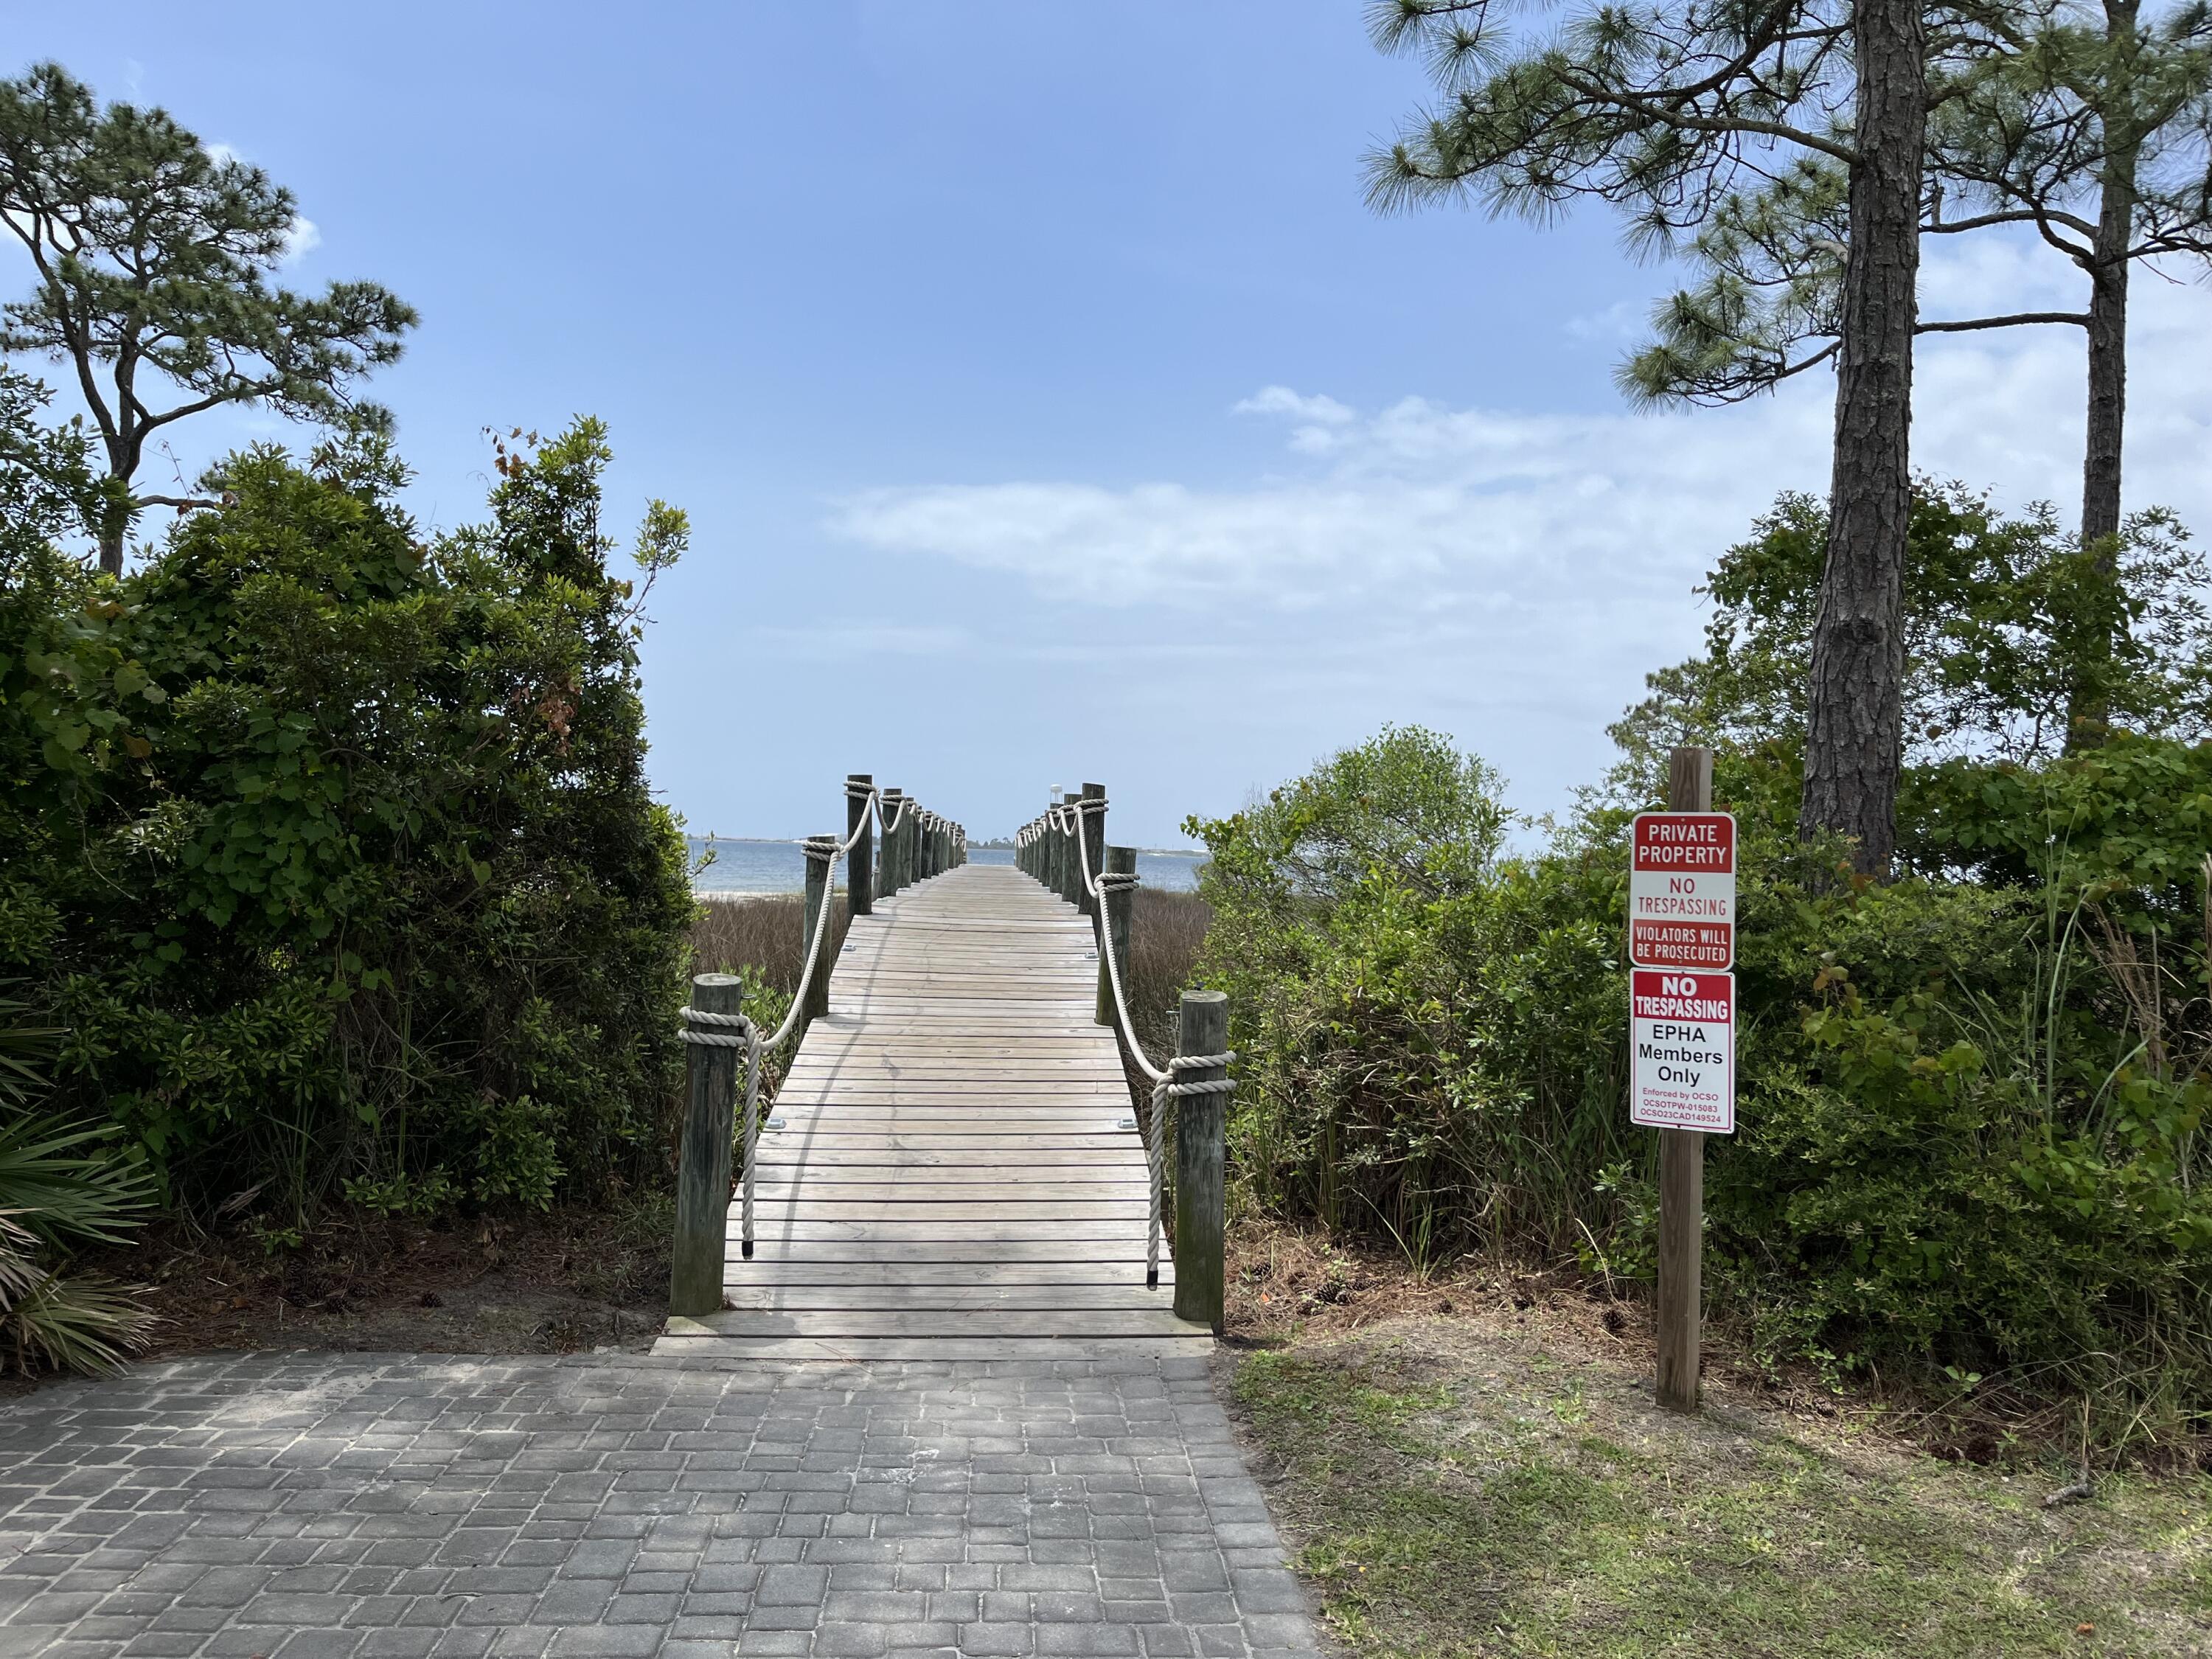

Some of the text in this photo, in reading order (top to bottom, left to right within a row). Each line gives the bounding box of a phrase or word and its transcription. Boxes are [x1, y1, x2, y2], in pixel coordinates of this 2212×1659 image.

[1649, 824, 1717, 842] PRIVATE
[1639, 846, 1726, 864] PROPERTY
[1670, 877, 1695, 894] NO
[1638, 897, 1726, 916] TRESPASSING
[1636, 926, 1728, 945] VIOLATORS WILL
[1636, 943, 1726, 961] BE PROSECUTED
[1662, 976, 1697, 996] NO
[1635, 995, 1728, 1020] TRESPASSING
[1653, 1024, 1706, 1043] EPHA
[1640, 1043, 1722, 1064] Members
[1658, 1066, 1700, 1088] Only
[1643, 1088, 1719, 1101] Enforced by OCSO
